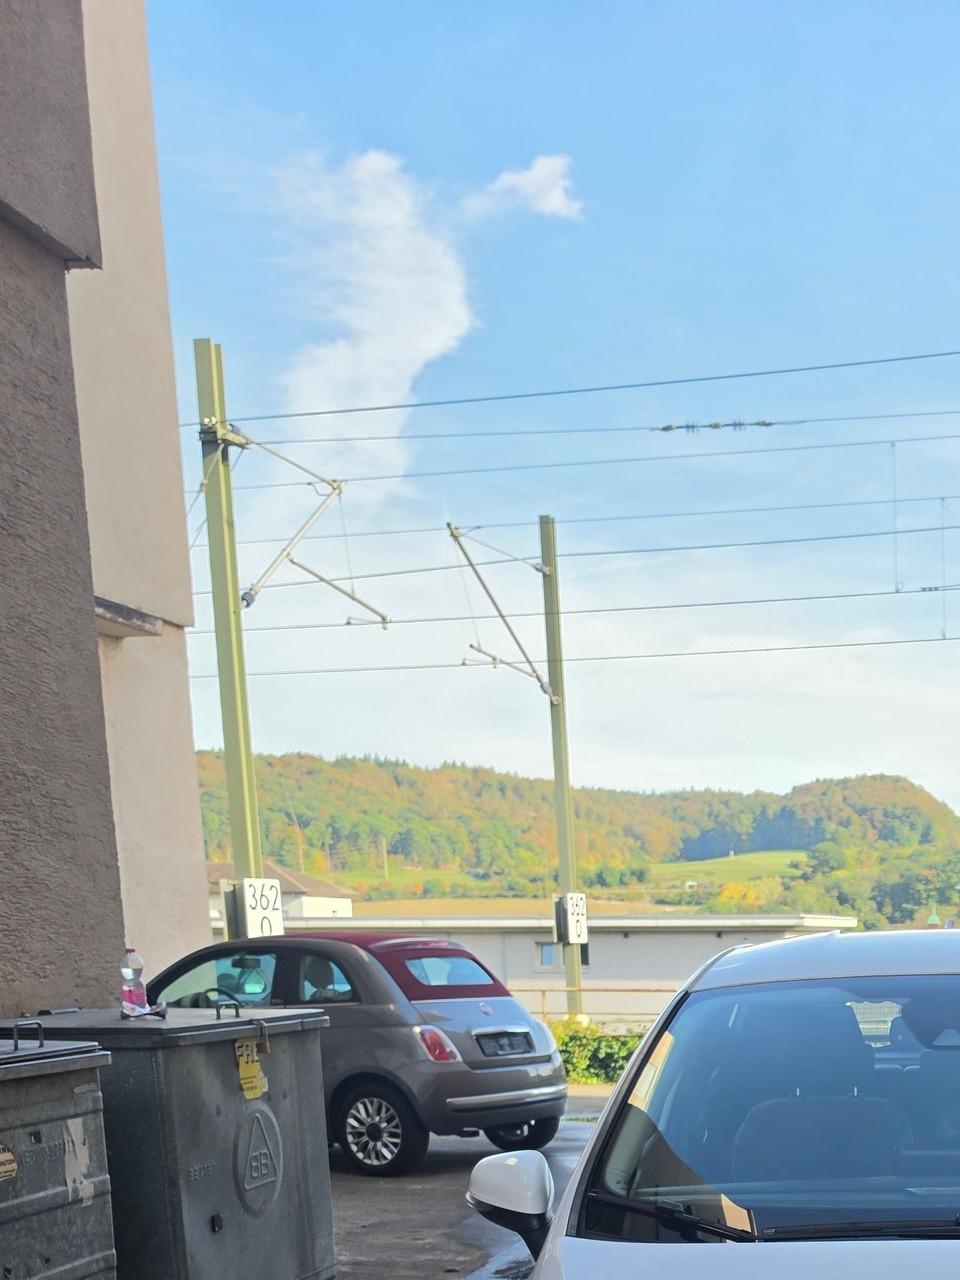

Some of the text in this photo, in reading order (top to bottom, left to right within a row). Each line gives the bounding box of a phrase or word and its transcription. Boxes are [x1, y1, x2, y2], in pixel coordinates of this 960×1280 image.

[248, 883, 280, 911] 362
[261, 915, 273, 937] 0
[575, 919, 583, 938] 0
